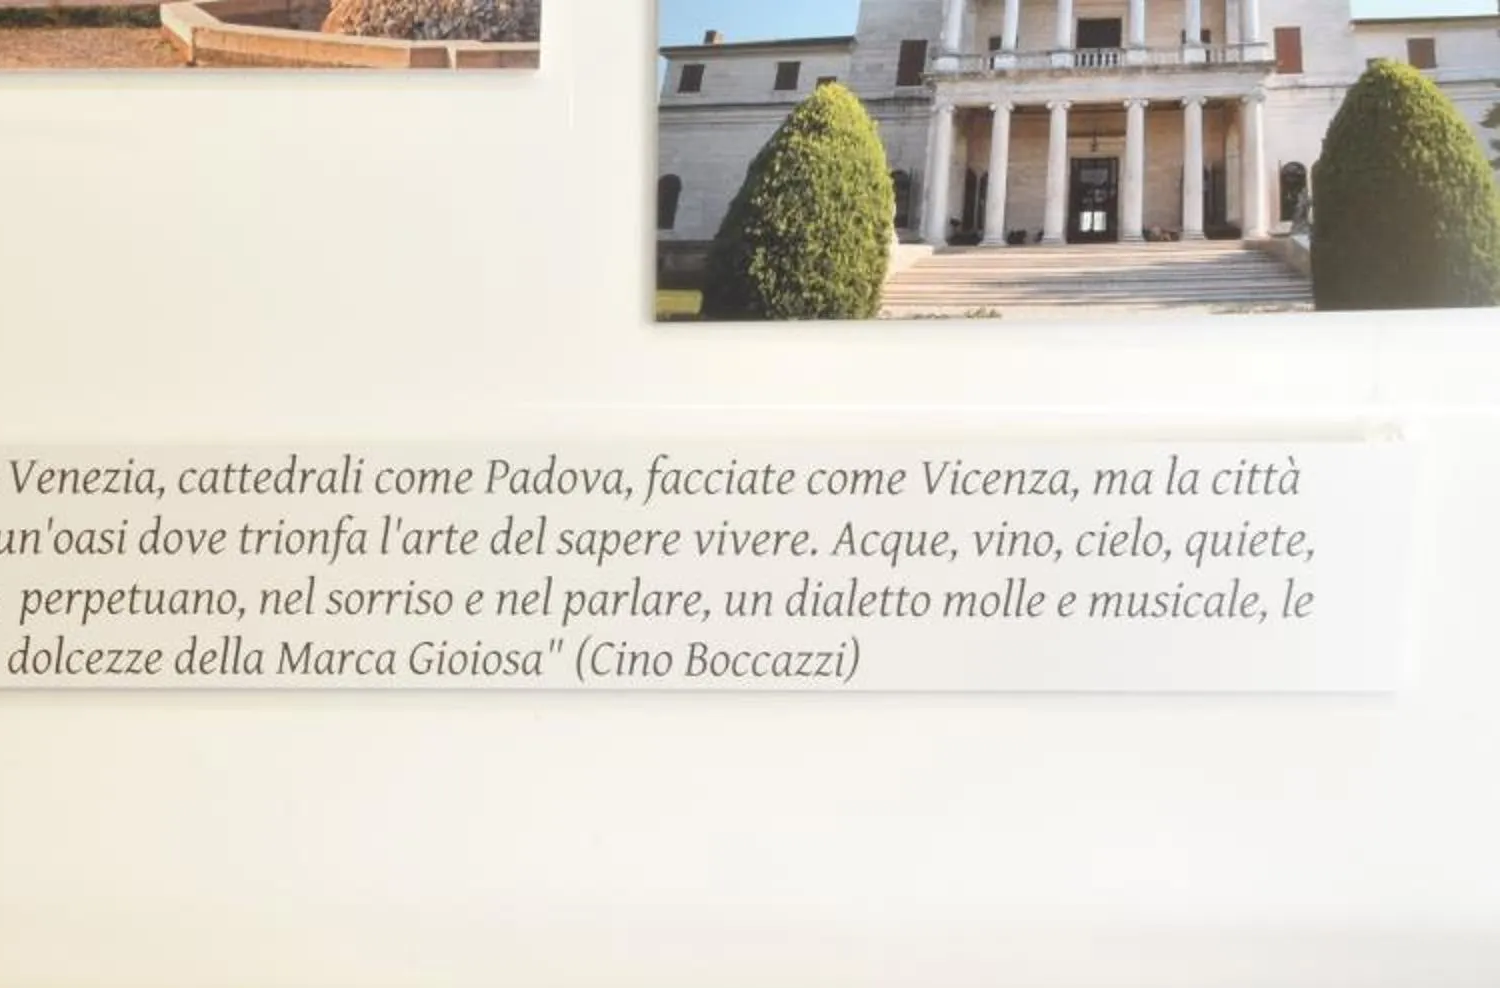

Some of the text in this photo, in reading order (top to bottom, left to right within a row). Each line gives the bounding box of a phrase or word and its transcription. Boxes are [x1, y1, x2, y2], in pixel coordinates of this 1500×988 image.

[9, 457, 166, 501] Venezia,
[177, 452, 365, 496] cattedrali
[374, 467, 474, 496] come
[484, 453, 633, 501] Padova,
[642, 453, 796, 506] facciate
[806, 468, 907, 497] come
[921, 458, 1080, 503] Vicenza,
[1092, 468, 1154, 496] ma
[1165, 453, 1200, 496] la
[1211, 455, 1301, 496] città
[137, 514, 228, 556] dove
[238, 513, 368, 566] trionfa
[380, 513, 480, 556] l'arte
[489, 514, 548, 557] del
[555, 528, 682, 568] sapere
[693, 519, 819, 558] vivere.
[829, 520, 959, 569] Acque,
[971, 520, 1063, 563] vino,
[1075, 515, 1172, 563] cielo,
[1185, 520, 1315, 569] quiete,
[18, 583, 246, 627] perpetuano,
[259, 574, 316, 616] nel
[324, 579, 454, 617] sorriso
[464, 589, 485, 617] e
[495, 575, 554, 617] nel
[561, 575, 711, 628] parlare,
[725, 590, 773, 618] un
[784, 576, 932, 618] dialetto
[942, 576, 1047, 619] molle
[1056, 591, 1077, 619] e
[1088, 577, 1268, 625] musicale,
[1282, 577, 1315, 619] le
[7, 634, 861, 683] dolcezze della Marca Gioiosa" (Cino Boccazzi)
